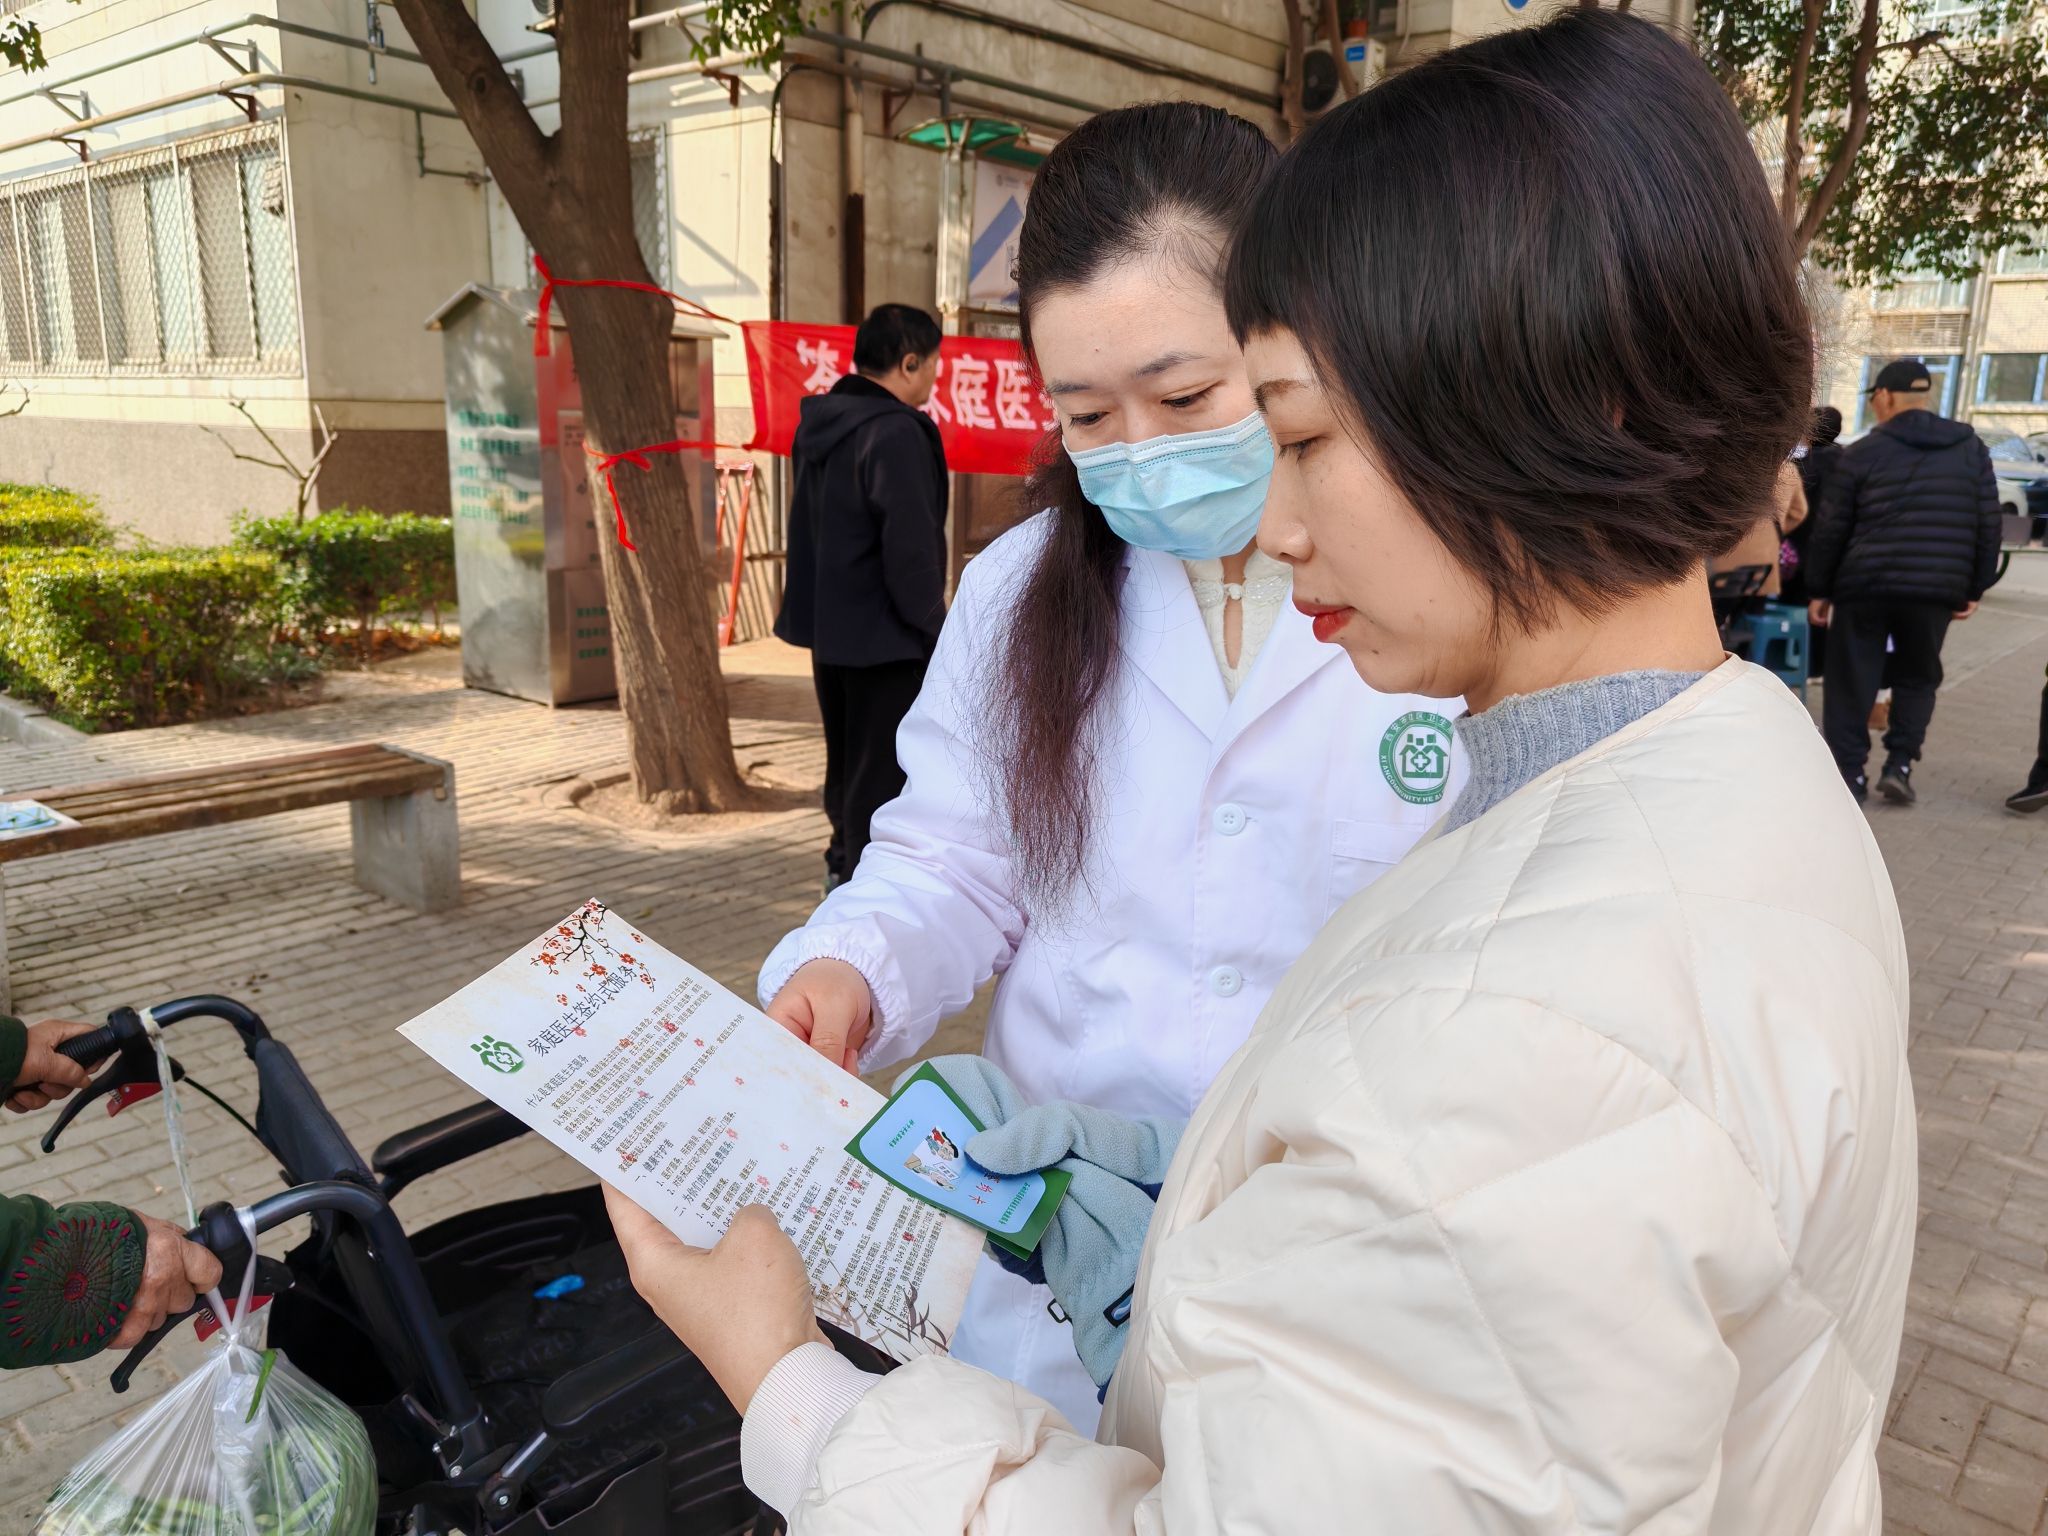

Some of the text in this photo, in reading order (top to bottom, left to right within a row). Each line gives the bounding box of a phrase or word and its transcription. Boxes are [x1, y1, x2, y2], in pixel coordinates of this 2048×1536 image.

[528, 965, 637, 1057] 家庭医生签约式服务
[526, 1054, 590, 1108] 什么是家庭医生式服务
[590, 1092, 653, 1154] 家庭医生服务签约的好处
[631, 1139, 674, 1185] 一、健康守护者
